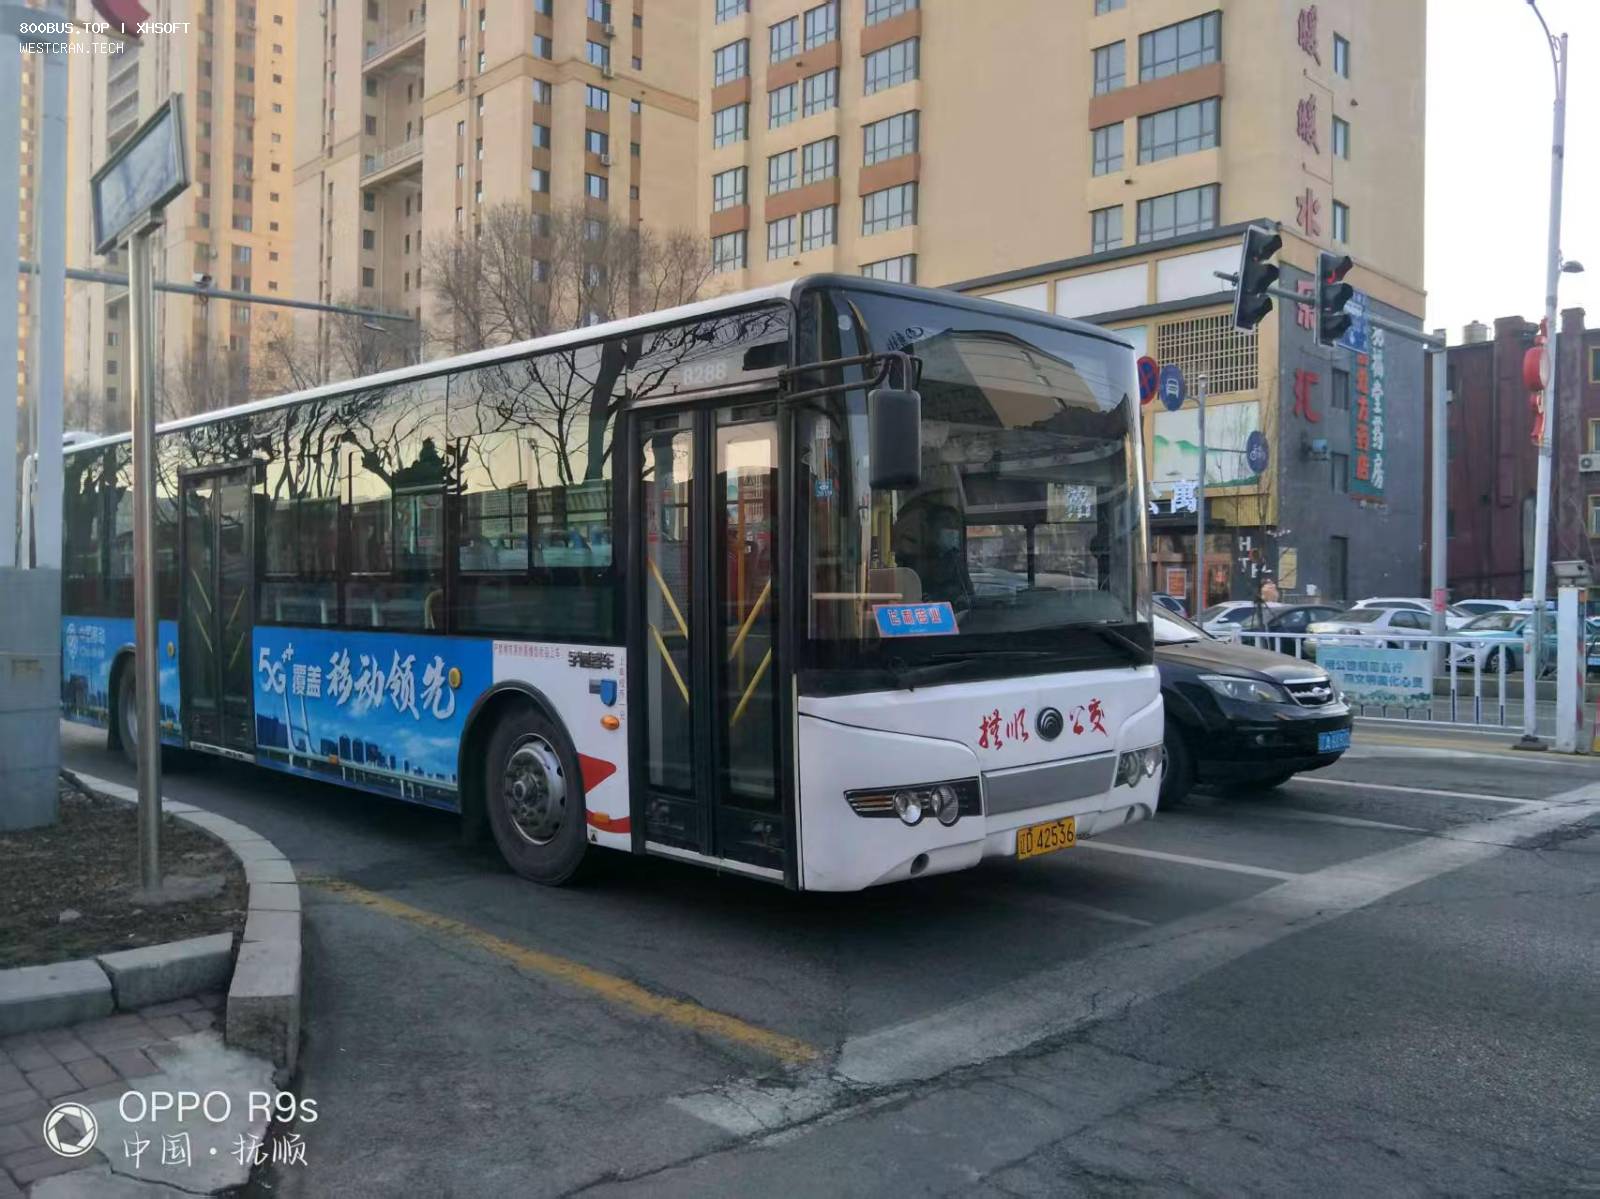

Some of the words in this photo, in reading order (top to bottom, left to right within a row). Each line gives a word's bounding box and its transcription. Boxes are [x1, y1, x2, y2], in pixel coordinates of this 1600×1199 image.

[292, 663, 322, 698] 覆盖
[326, 648, 456, 721] 移动领先
